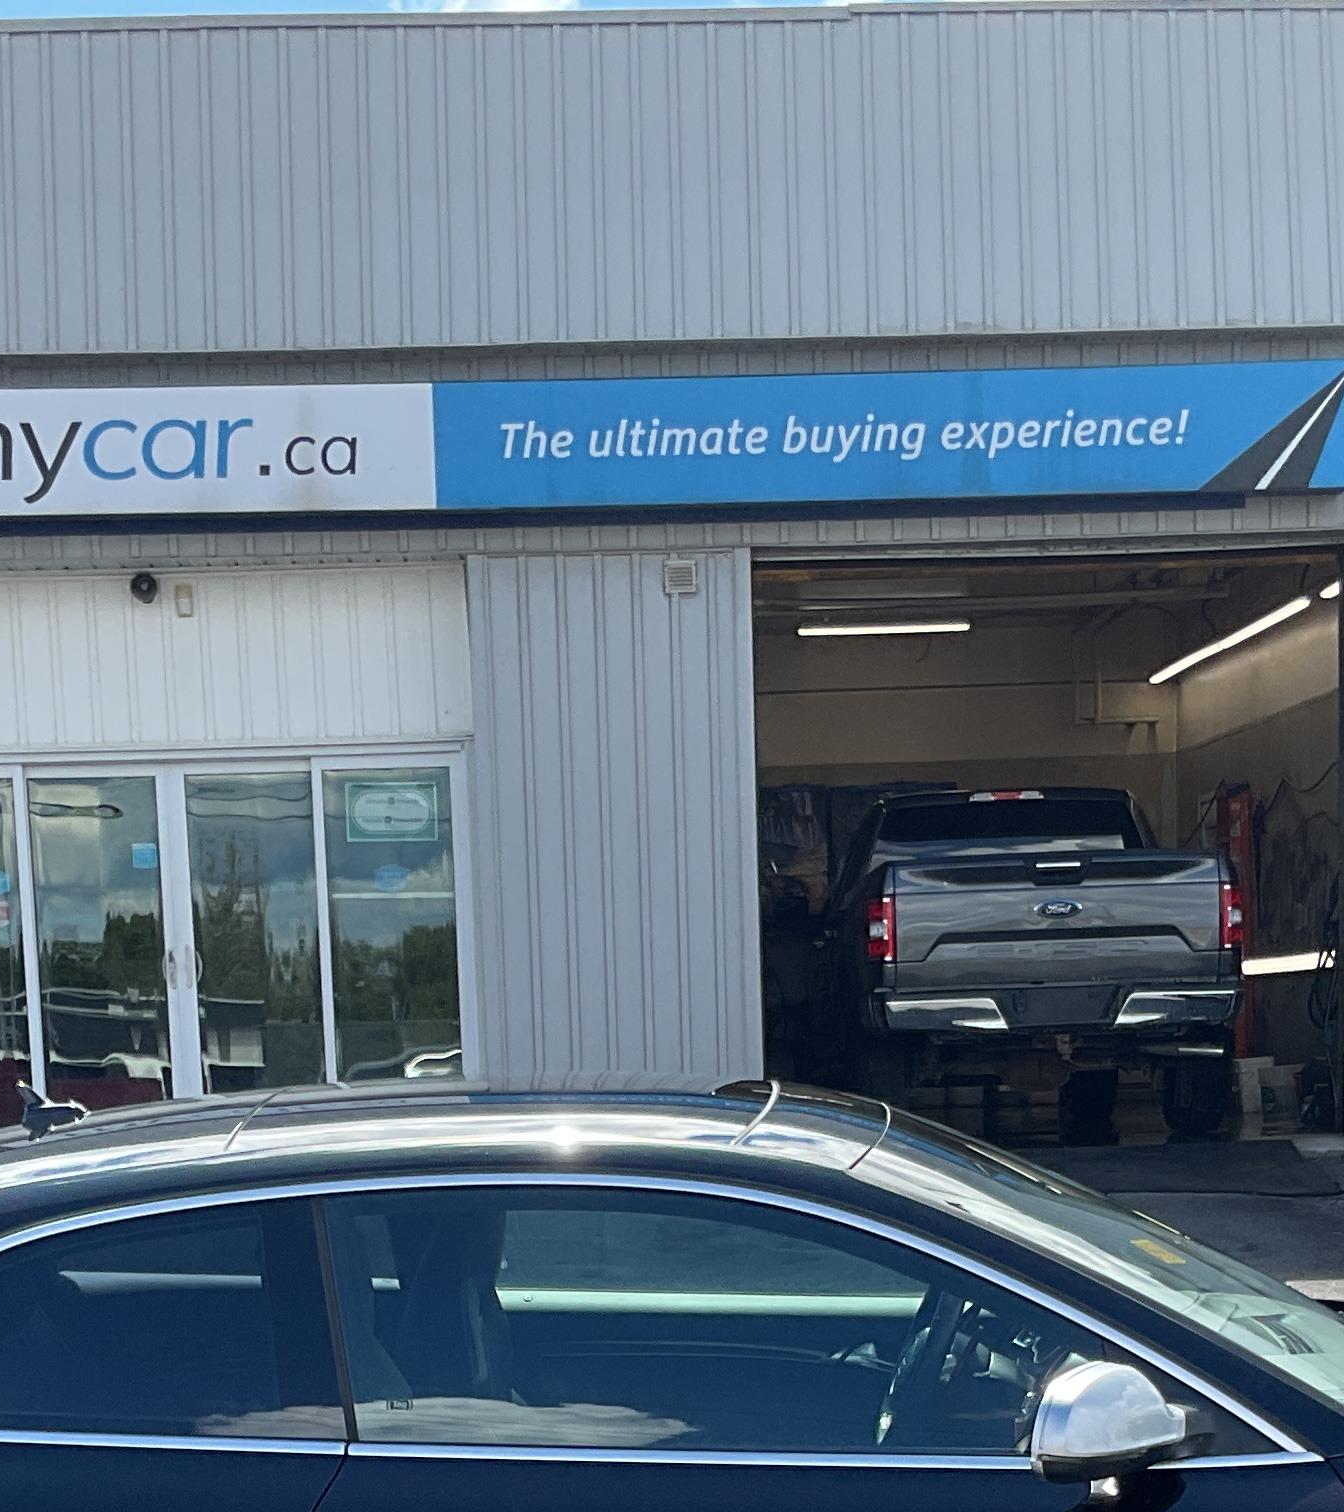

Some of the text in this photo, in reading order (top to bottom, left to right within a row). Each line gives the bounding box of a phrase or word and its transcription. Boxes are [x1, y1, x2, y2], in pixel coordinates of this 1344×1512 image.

[500, 408, 1190, 463] The ultimate buying experience!
